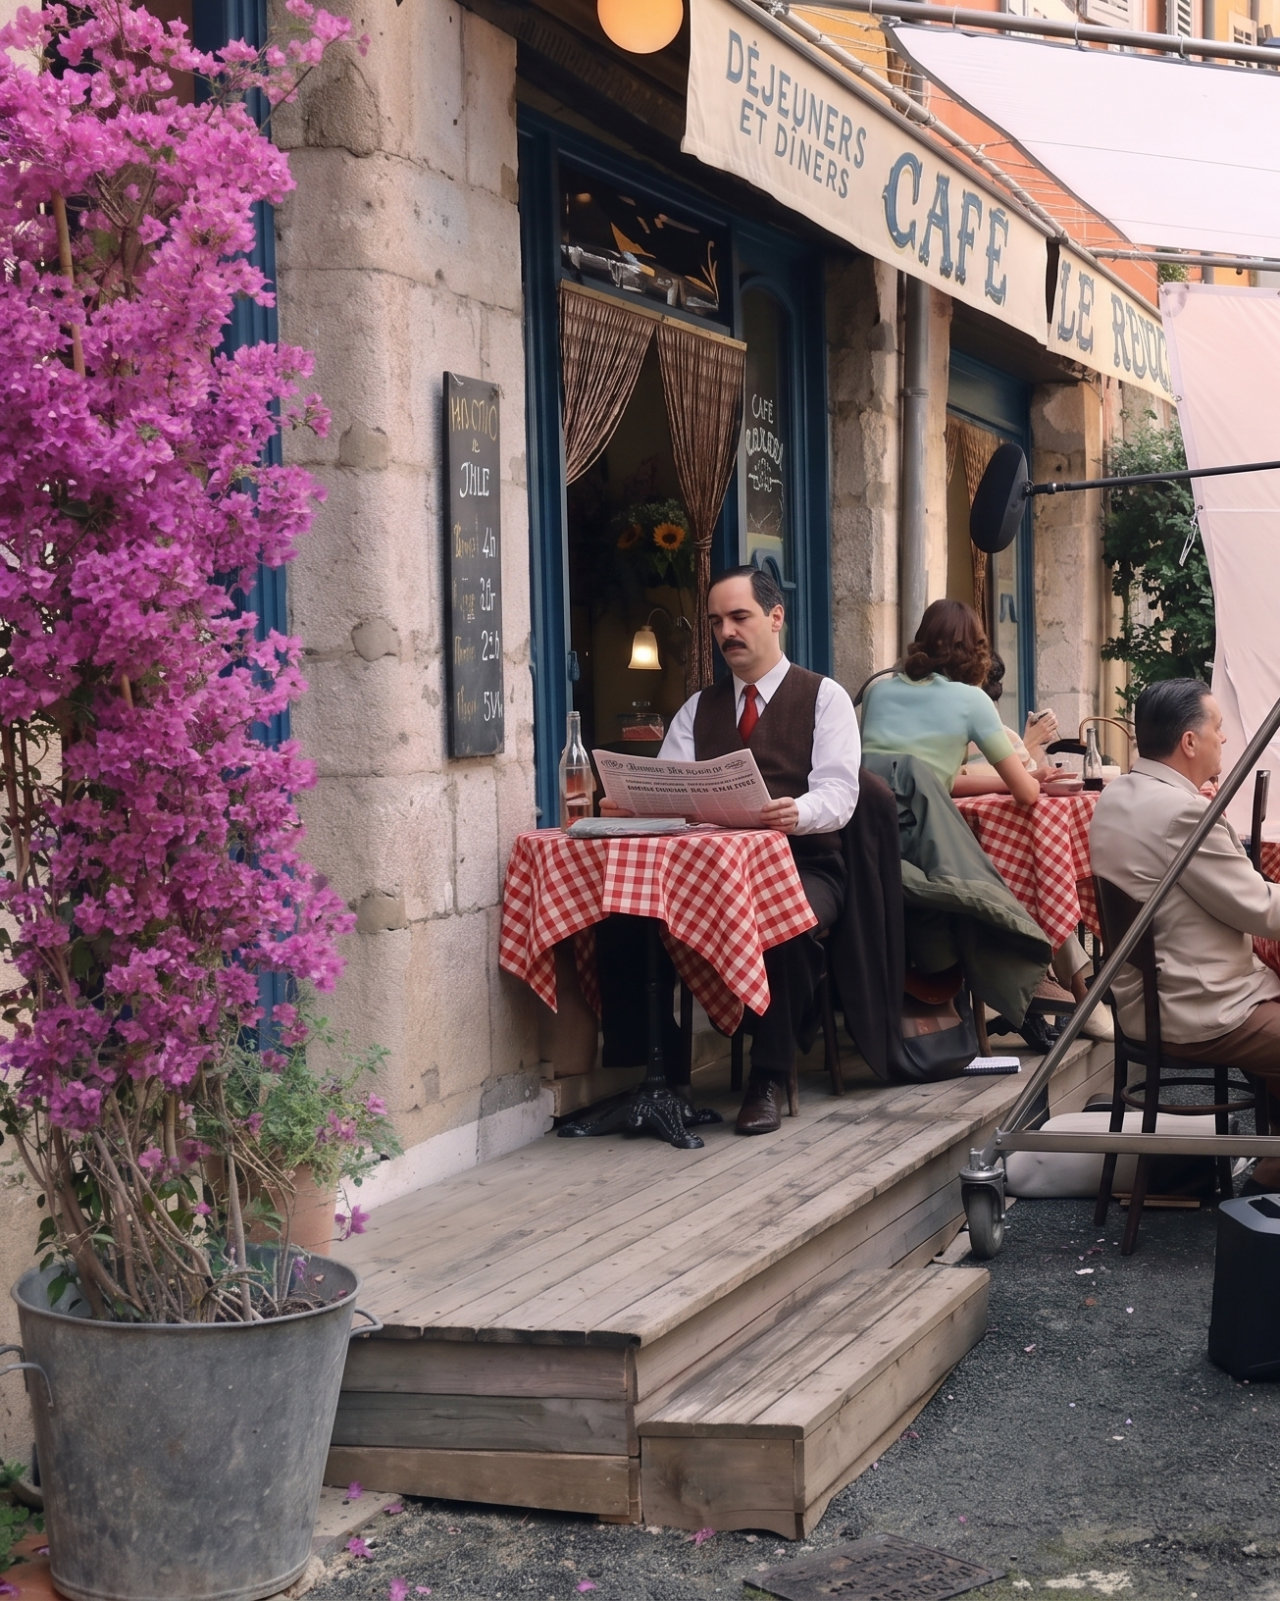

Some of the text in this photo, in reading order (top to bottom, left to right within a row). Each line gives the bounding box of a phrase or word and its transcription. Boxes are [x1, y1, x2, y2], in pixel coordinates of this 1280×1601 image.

[726, 28, 867, 170] DÉJEUNERS
[739, 98, 850, 199] ET DÎNERS
[1057, 259, 1095, 356] LE
[751, 393, 774, 424] CAFÉ
